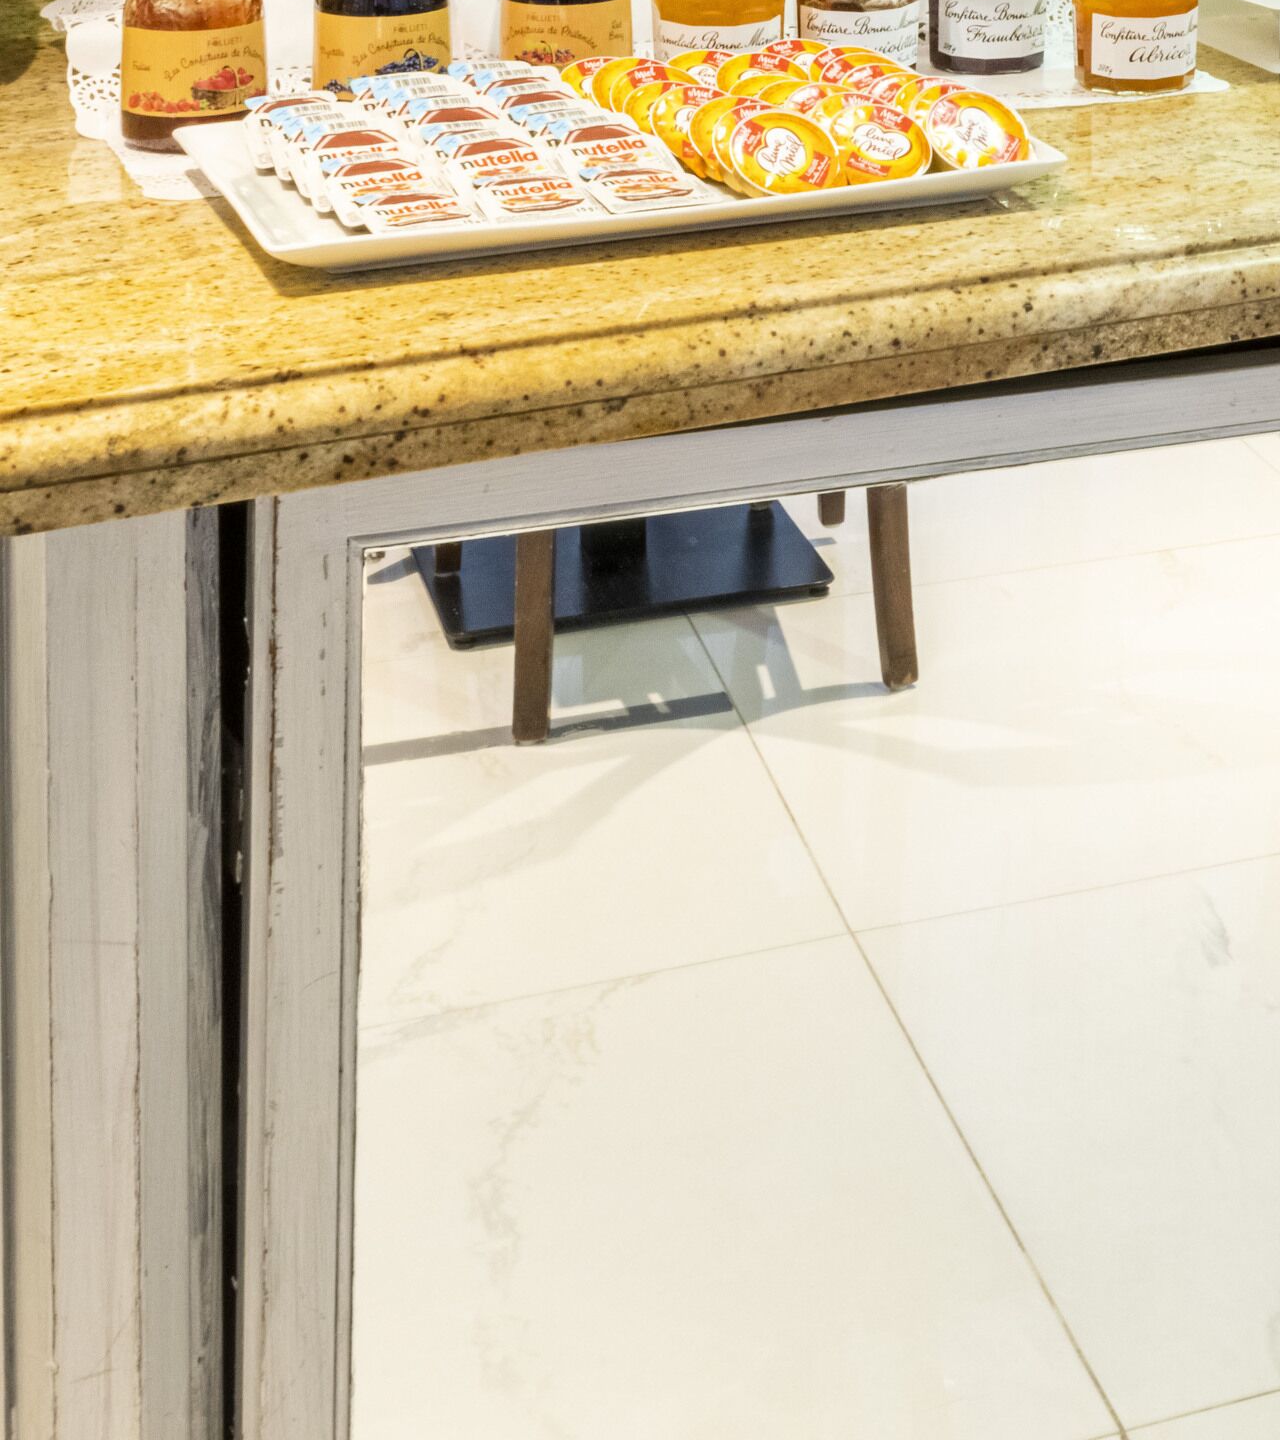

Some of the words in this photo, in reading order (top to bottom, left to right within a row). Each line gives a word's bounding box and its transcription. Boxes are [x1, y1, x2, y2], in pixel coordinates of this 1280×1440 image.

[944, 0, 989, 22] Confiture
[993, 2, 1028, 21] Bonne
[806, 12, 850, 36] Confiture
[853, 15, 892, 35] Bonne
[1099, 21, 1150, 44] Confiture
[1152, 21, 1185, 41] Bonne
[701, 30, 743, 50] Bonne
[572, 139, 647, 157] nutella
[461, 150, 539, 170] nutella
[340, 171, 422, 190] nutella
[492, 180, 573, 197] nutella
[602, 174, 678, 188] nutella
[375, 201, 458, 216] nutella
